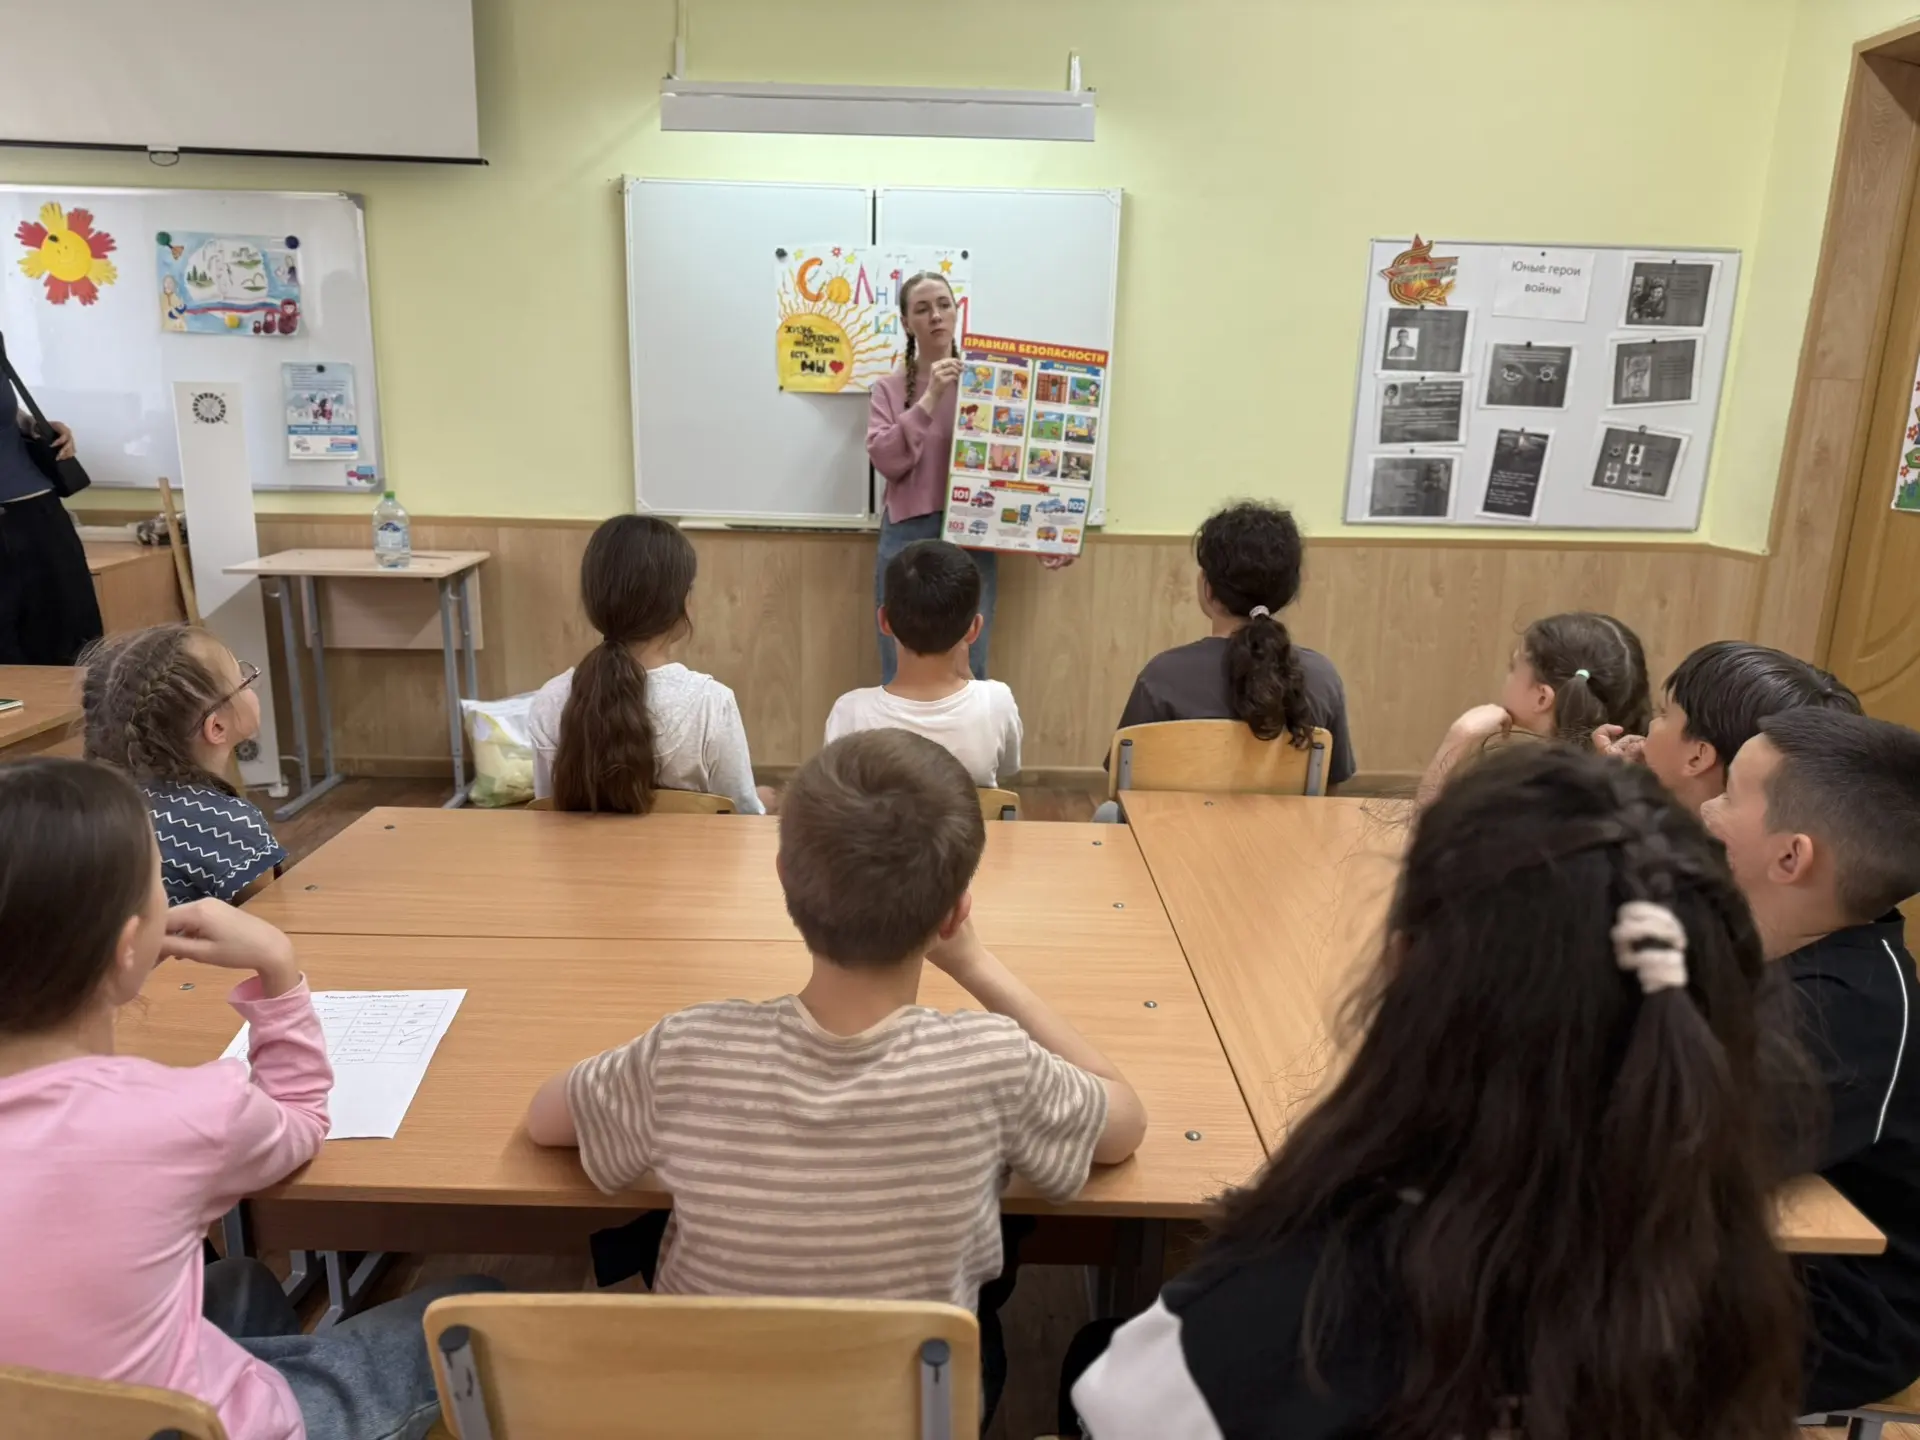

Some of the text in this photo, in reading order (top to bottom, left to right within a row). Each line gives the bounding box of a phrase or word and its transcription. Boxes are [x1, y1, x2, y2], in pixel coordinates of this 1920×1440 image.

[1511, 261, 1582, 277] Юные герои
[1524, 283, 1562, 294] войны
[790, 350, 808, 359] ЕСТЬ
[963, 337, 1106, 363] ПРАВИЛА БЕЗОПАСНОСТИ
[800, 359, 826, 374] МЫ
[953, 489, 970, 500] 101
[1068, 501, 1085, 511] 102
